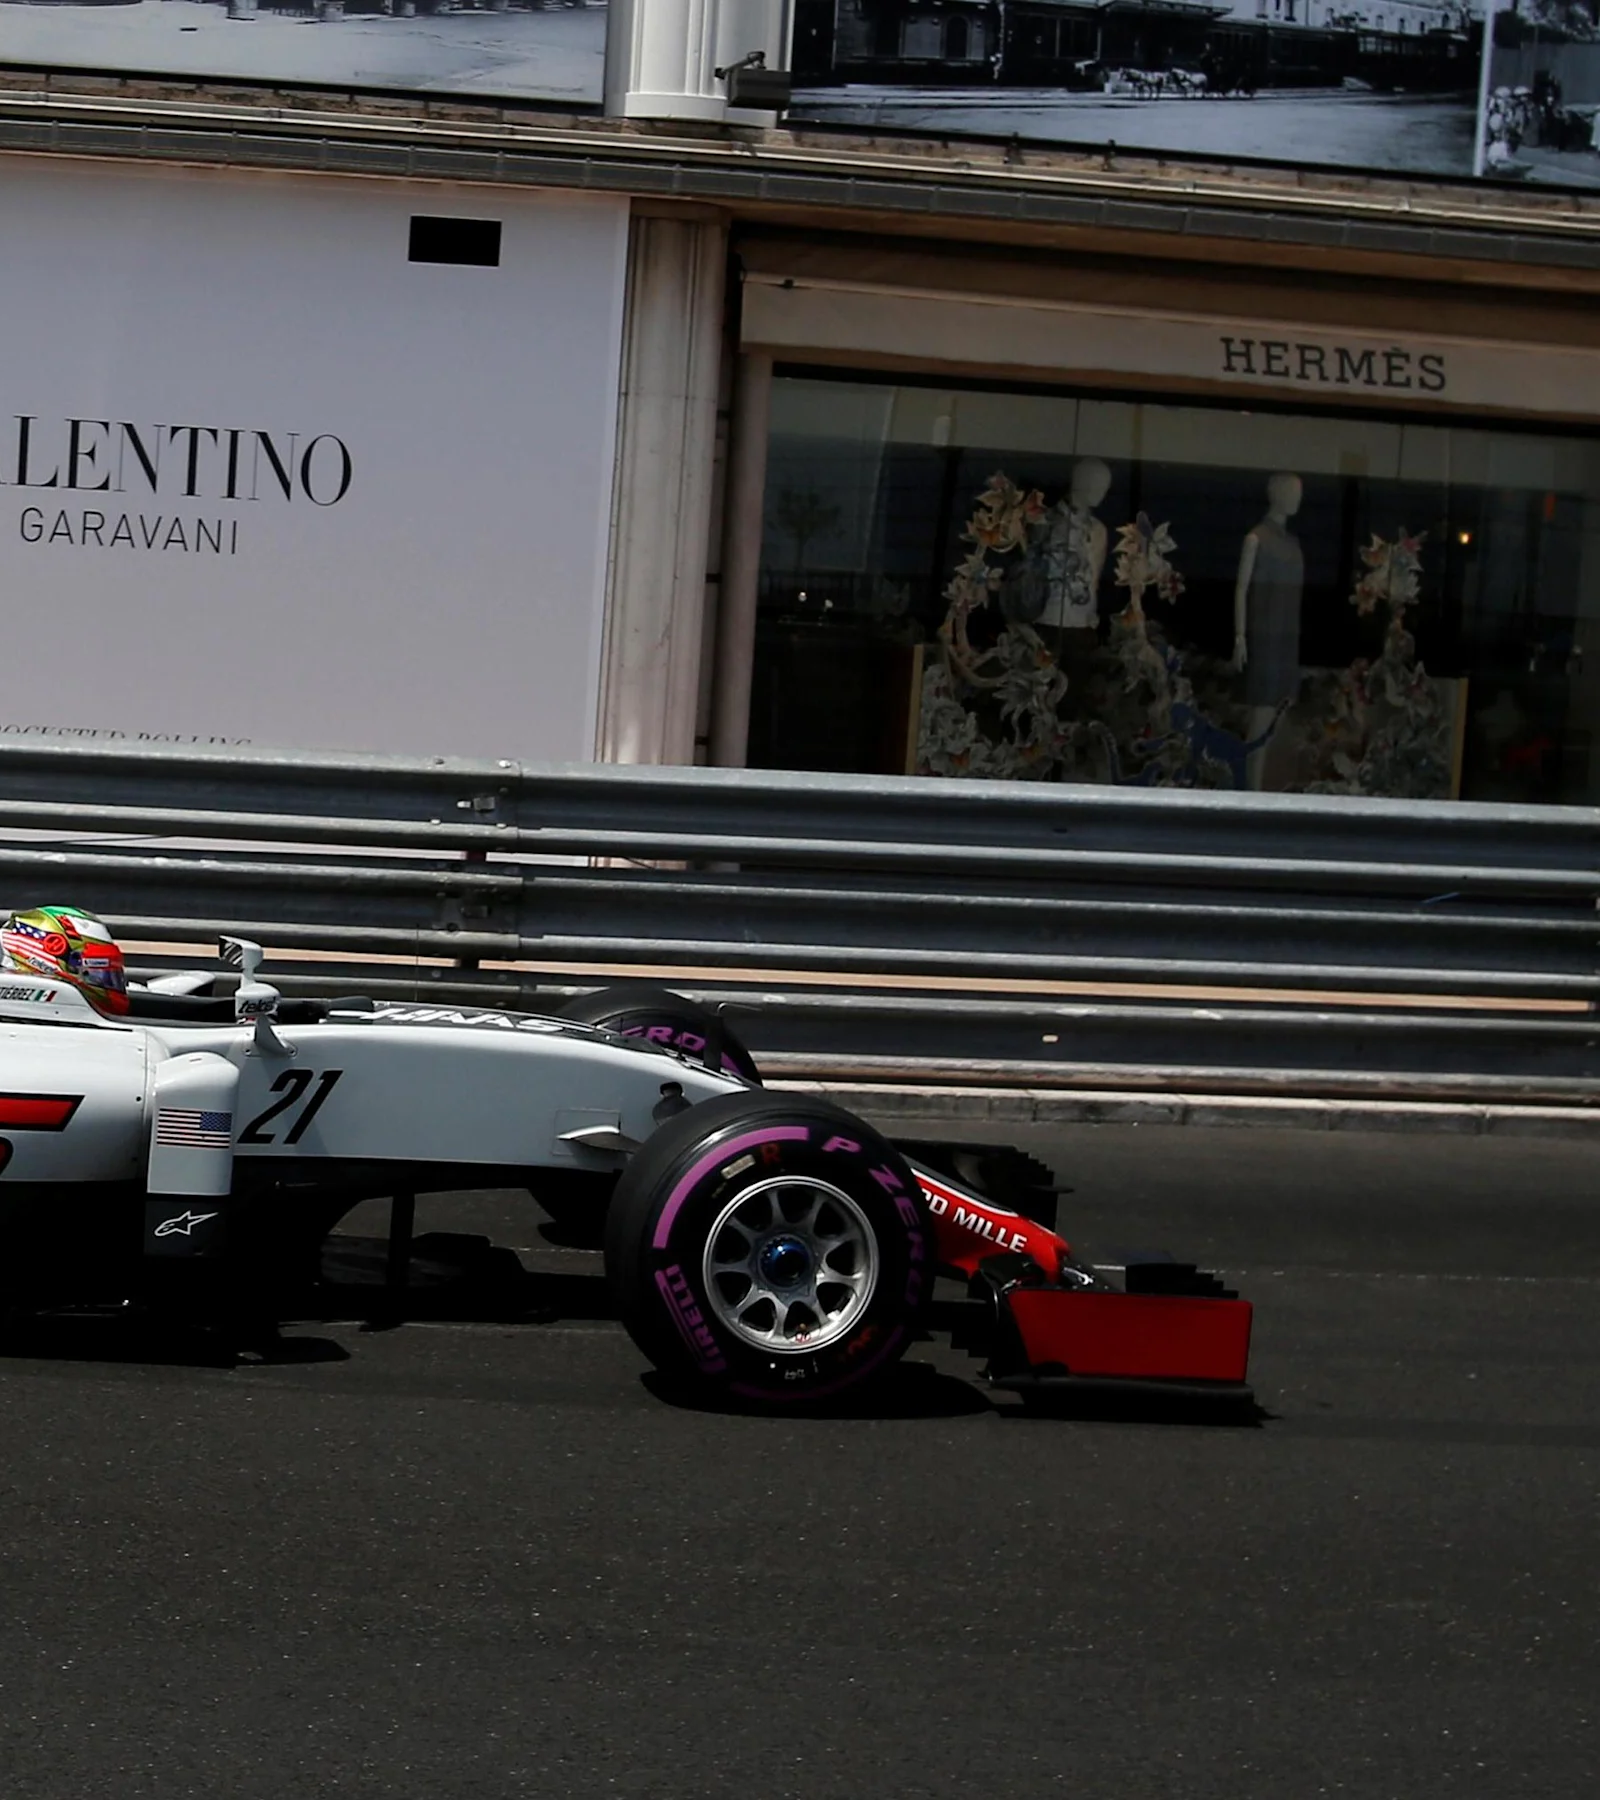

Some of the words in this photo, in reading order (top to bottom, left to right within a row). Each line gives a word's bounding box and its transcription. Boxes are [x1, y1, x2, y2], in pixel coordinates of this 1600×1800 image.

[1220, 337, 1446, 391] HERMÈS
[19, 506, 238, 554] GARAVANI
[237, 1068, 343, 1145] 21
[820, 1135, 863, 1154] P
[867, 1163, 925, 1308] ZERO
[952, 1206, 1028, 1253] MILLE
[653, 1262, 731, 1375] PIRELLI
